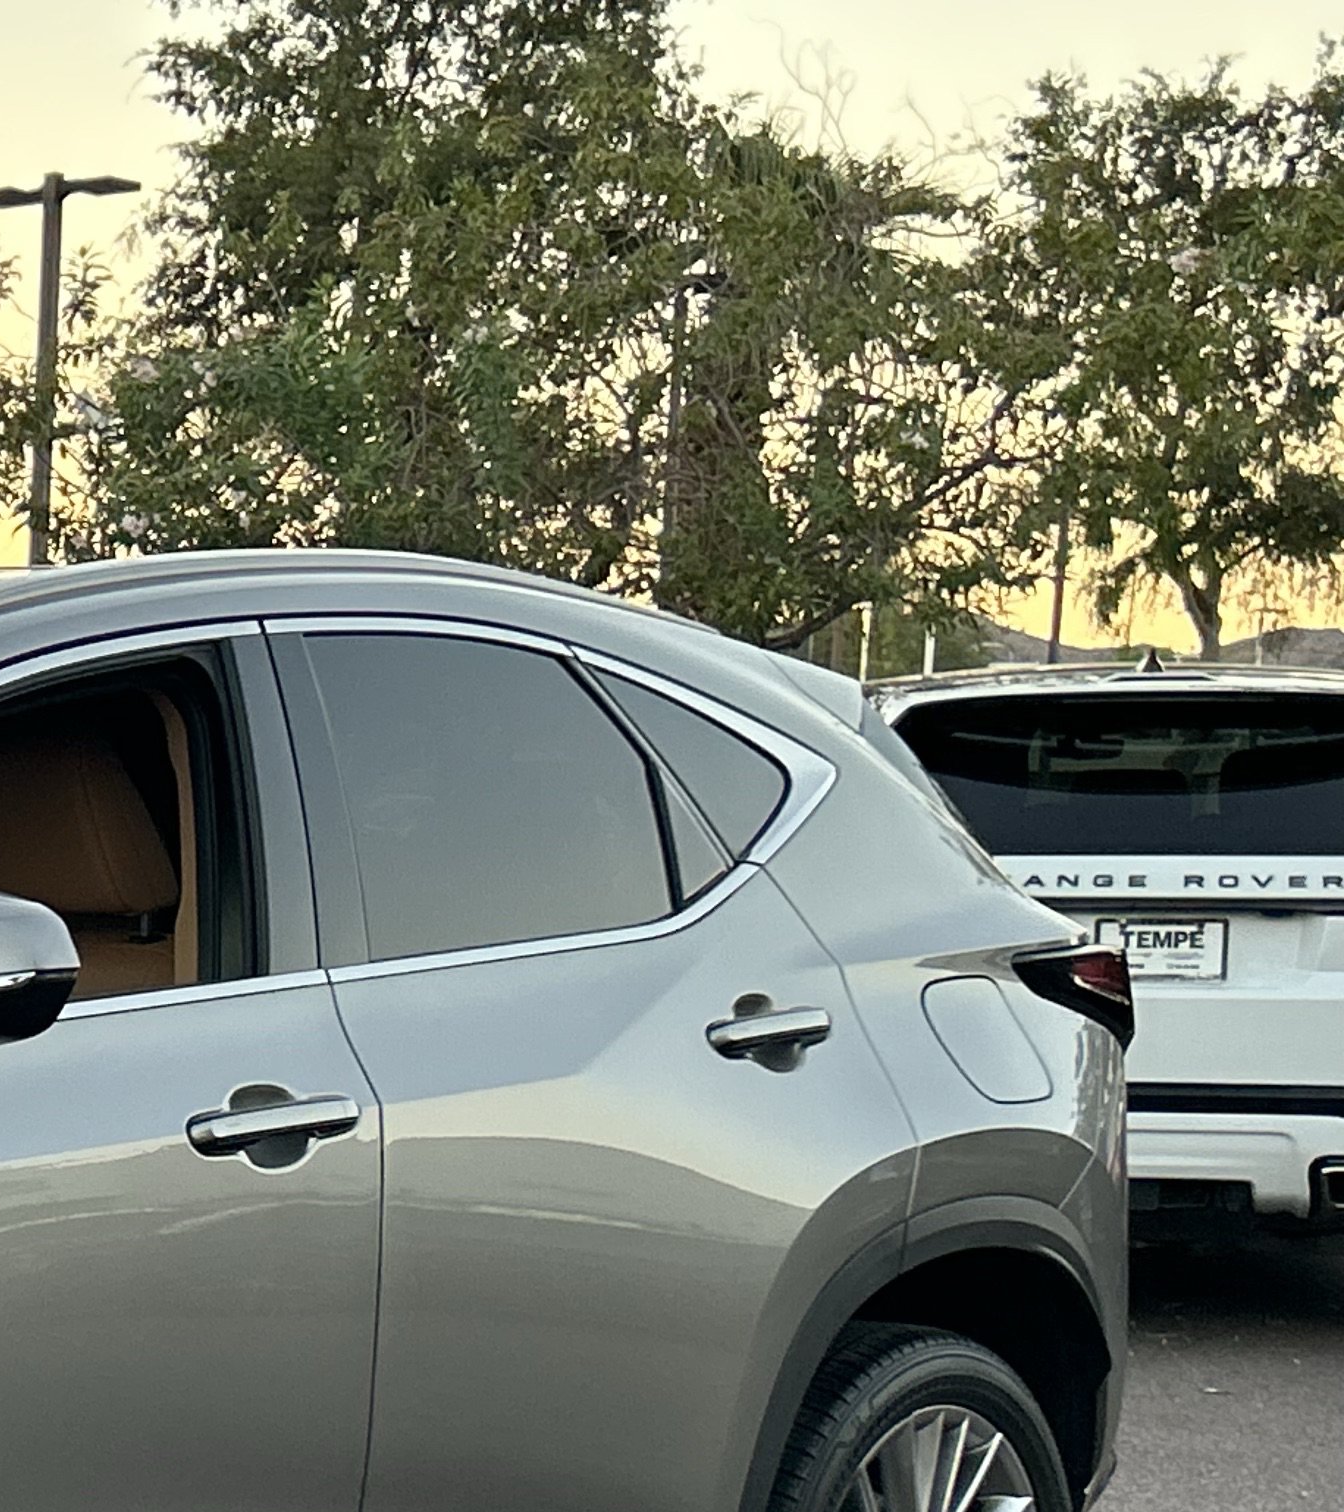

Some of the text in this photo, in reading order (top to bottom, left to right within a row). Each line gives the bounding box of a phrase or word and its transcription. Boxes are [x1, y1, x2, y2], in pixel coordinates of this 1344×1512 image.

[1023, 874, 1344, 889] ANGE ROVER
[1119, 931, 1205, 949] TEMPE
